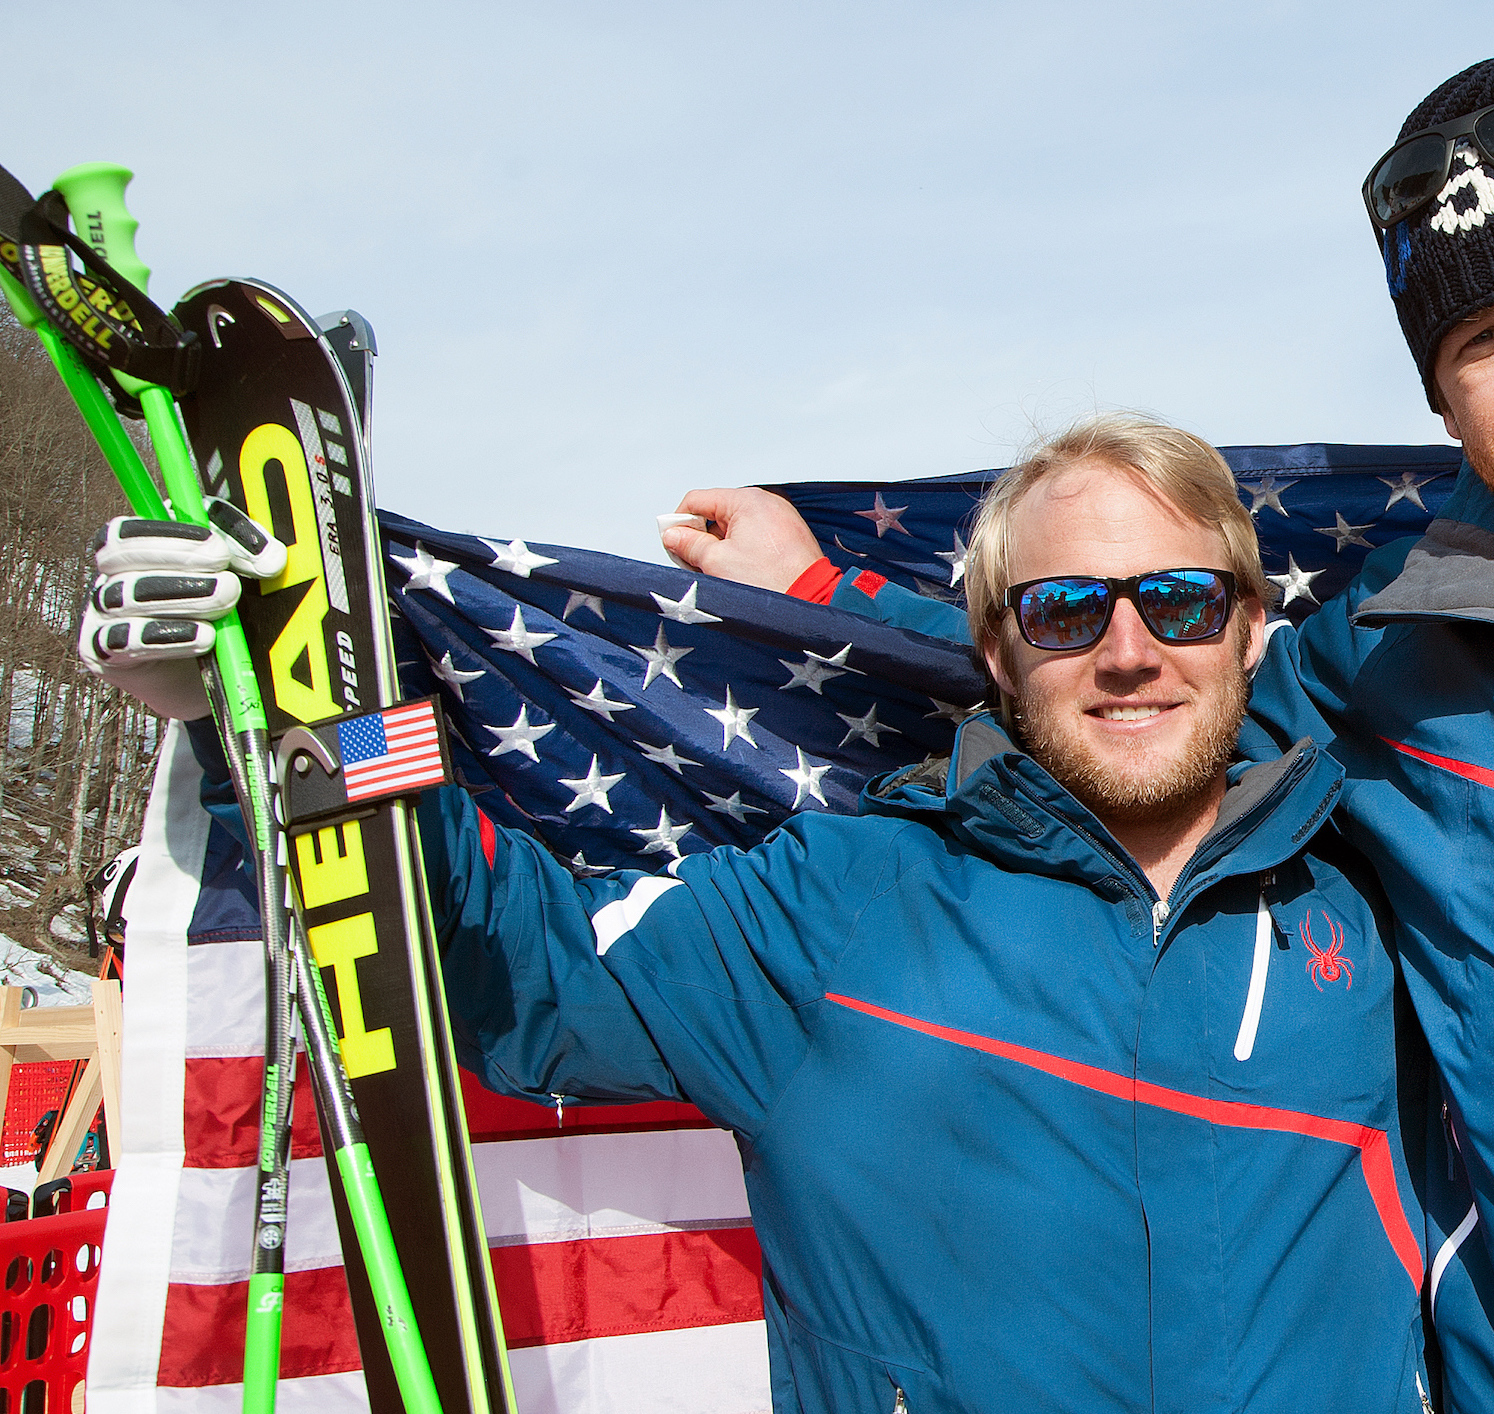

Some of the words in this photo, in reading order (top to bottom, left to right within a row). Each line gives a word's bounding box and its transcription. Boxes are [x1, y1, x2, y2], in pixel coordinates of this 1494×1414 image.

[316, 472, 333, 505] 3.0
[329, 522, 341, 557] ERA
[336, 630, 361, 712] PEED
[239, 423, 398, 1080] HEAD
[245, 753, 270, 851] KOMPERDELL
[308, 957, 342, 1055] KOMPERDELL
[261, 1063, 280, 1173] KOMPERDELL
